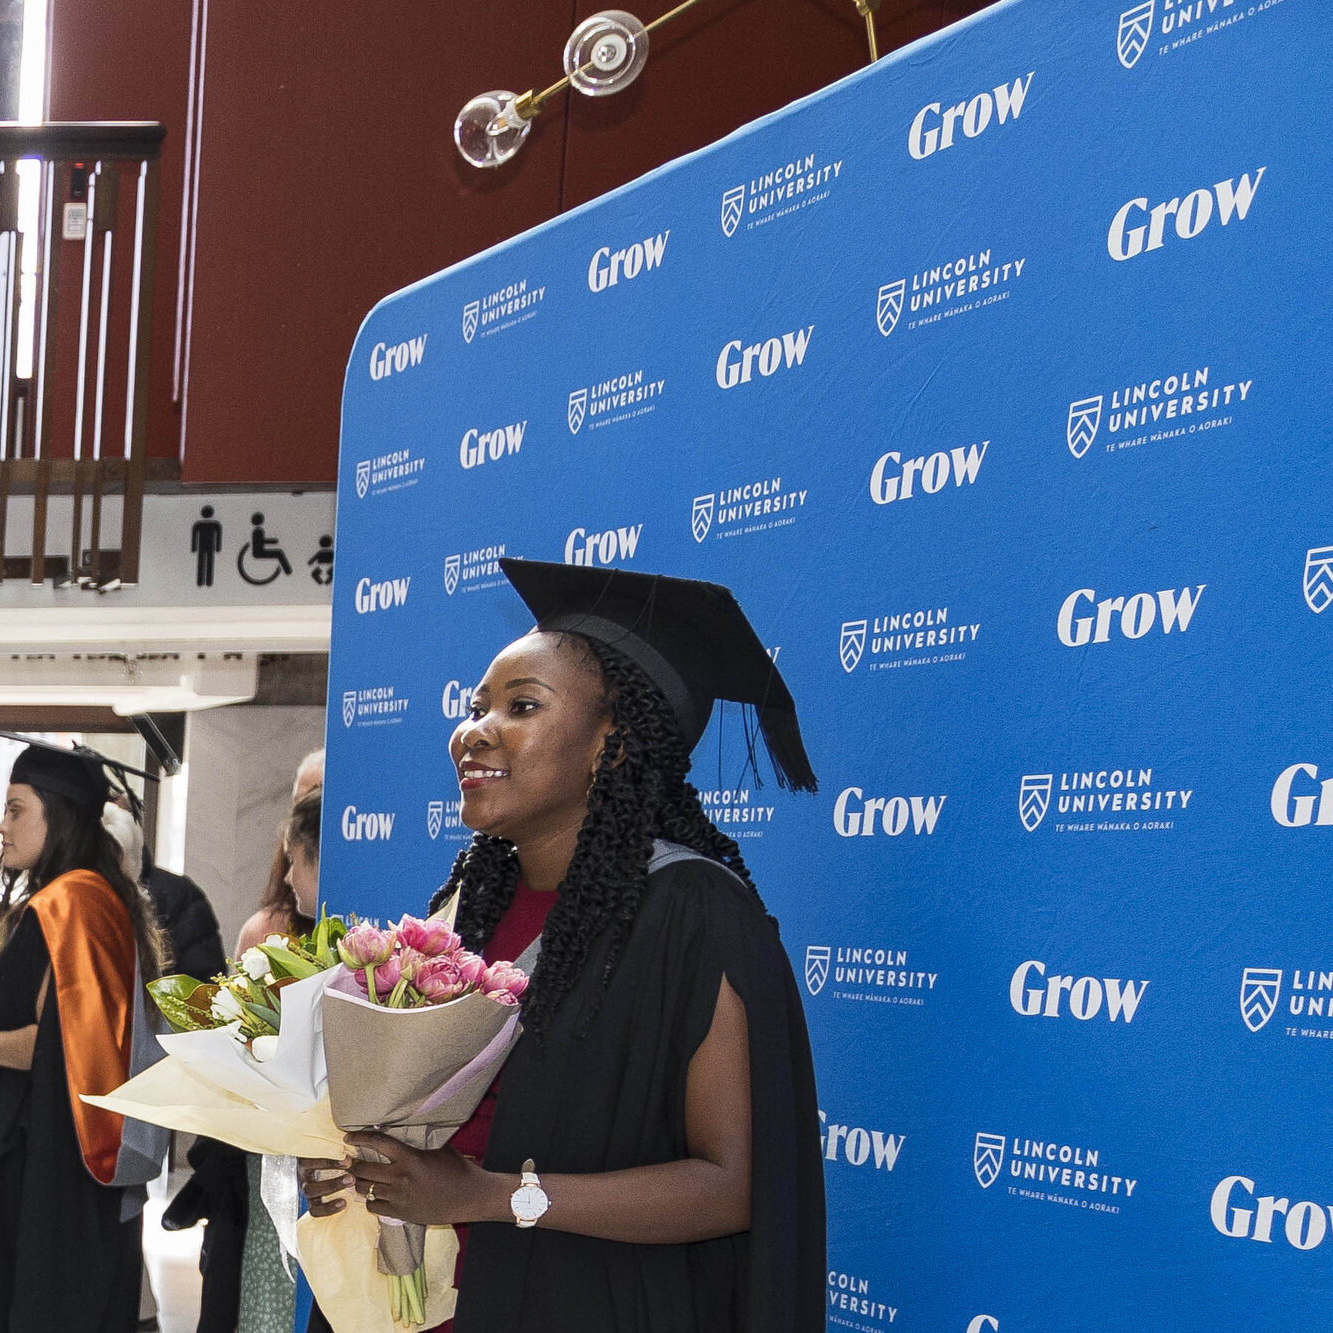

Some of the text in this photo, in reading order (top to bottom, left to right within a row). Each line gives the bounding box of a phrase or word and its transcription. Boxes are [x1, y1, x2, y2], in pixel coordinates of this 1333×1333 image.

[1159, 43, 1170, 55] TE
[1172, 29, 1204, 50] WHARE
[909, 72, 1034, 159] Grow
[749, 161, 842, 213] UNIVERSITY
[751, 154, 814, 194] LINCOLN
[1108, 167, 1266, 260] Grow
[588, 230, 670, 292] Grow
[913, 250, 990, 290] LINCOLN
[483, 280, 526, 309] LINCOLN
[911, 259, 1025, 311] UNIVERSITY
[482, 287, 545, 325] UNIVERSITY
[907, 321, 916, 330] TE
[917, 313, 942, 327] WHARE
[982, 291, 1010, 307] AORAKI
[370, 334, 427, 380] Grow
[716, 325, 814, 389] Grow
[590, 380, 664, 415] UNIVERSITY
[592, 371, 642, 398] LINCOLN
[1112, 367, 1208, 409] LINCOLN
[1109, 381, 1252, 432] UNIVERSITY
[460, 421, 526, 469] Grow
[1105, 443, 1115, 453] TE
[1118, 436, 1148, 450] WHARE
[1198, 417, 1233, 433] AORAKI
[373, 450, 409, 469] LINCOLN
[373, 458, 424, 484] UNIVERSITY
[870, 441, 990, 504] Grow
[719, 491, 807, 523] UNIVERSITY
[720, 478, 780, 505] LINCOLN
[464, 545, 505, 565] LINCOLN
[565, 524, 643, 567] Grow
[463, 556, 523, 580] UNIVER
[356, 577, 410, 613] Grow
[874, 608, 947, 633] LINCOLN
[1057, 585, 1206, 646] Grow
[872, 624, 980, 653] UNIVERSITY
[358, 700, 408, 715] UNIVERSITY
[359, 687, 393, 701] LINCOLN
[442, 680, 472, 718] Gr
[1061, 769, 1151, 790] LINCOLN
[1271, 763, 1333, 827] Gr
[699, 790, 748, 805] INCOLN
[834, 787, 947, 837] Grow
[1059, 791, 1192, 813] UNIVERSITY
[342, 806, 395, 840] Grow
[1054, 824, 1064, 832] TE
[1141, 822, 1174, 830] AORAKI
[838, 948, 906, 965] LINCOLN
[836, 967, 937, 988] UNIVERSITY
[1010, 961, 1150, 1023] Grow
[1285, 1026, 1298, 1035] TE
[1013, 1139, 1098, 1166] LINCOLN
[1011, 1160, 1136, 1196] UNIVERSITY
[1007, 1187, 1016, 1195] TE
[1018, 1189, 1045, 1200] WHARE
[1088, 1202, 1119, 1214] AORAKI
[1211, 1176, 1333, 1250] Gro
[828, 1271, 868, 1293] COLN
[830, 1291, 897, 1322] VERSITY
